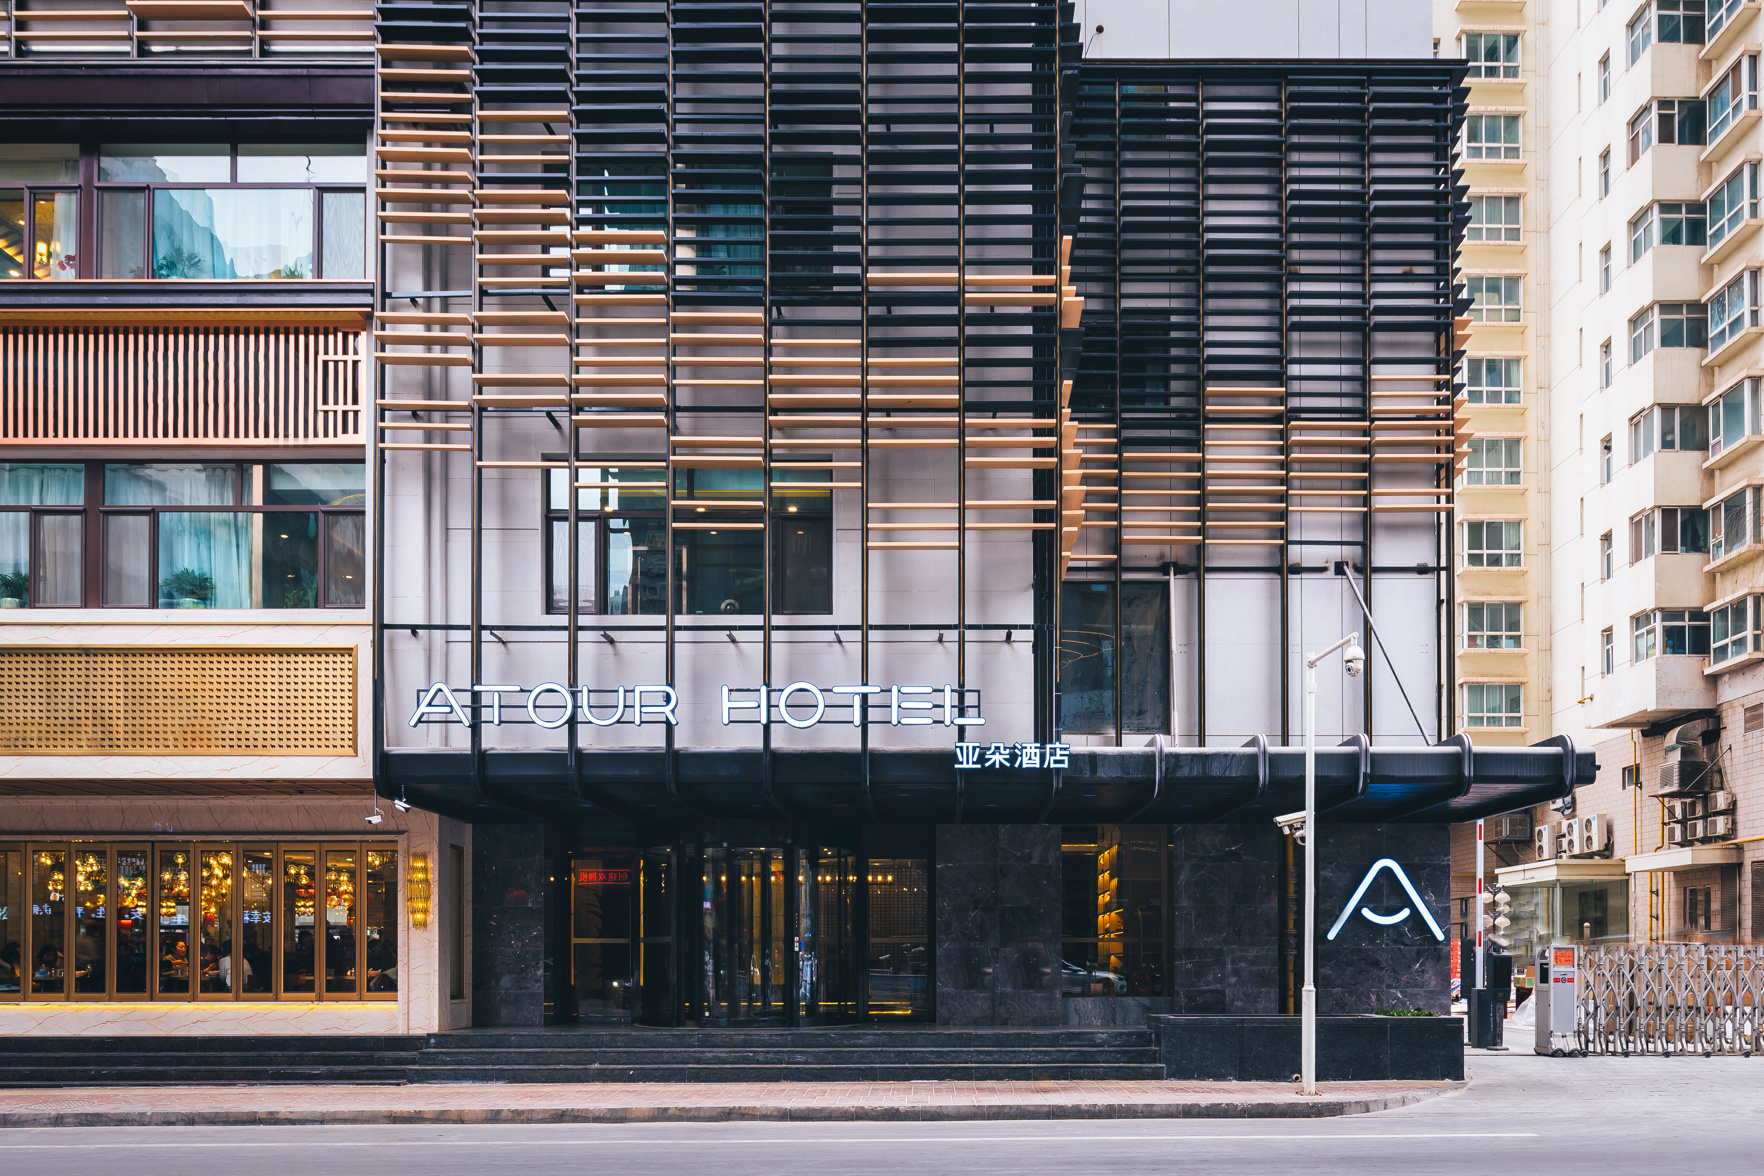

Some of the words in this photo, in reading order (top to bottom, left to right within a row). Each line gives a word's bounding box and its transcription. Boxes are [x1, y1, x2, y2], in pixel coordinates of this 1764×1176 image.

[408, 682, 679, 728] ATOUR
[720, 681, 986, 729] HOTEL
[954, 741, 1071, 769] 亚朵酒店
